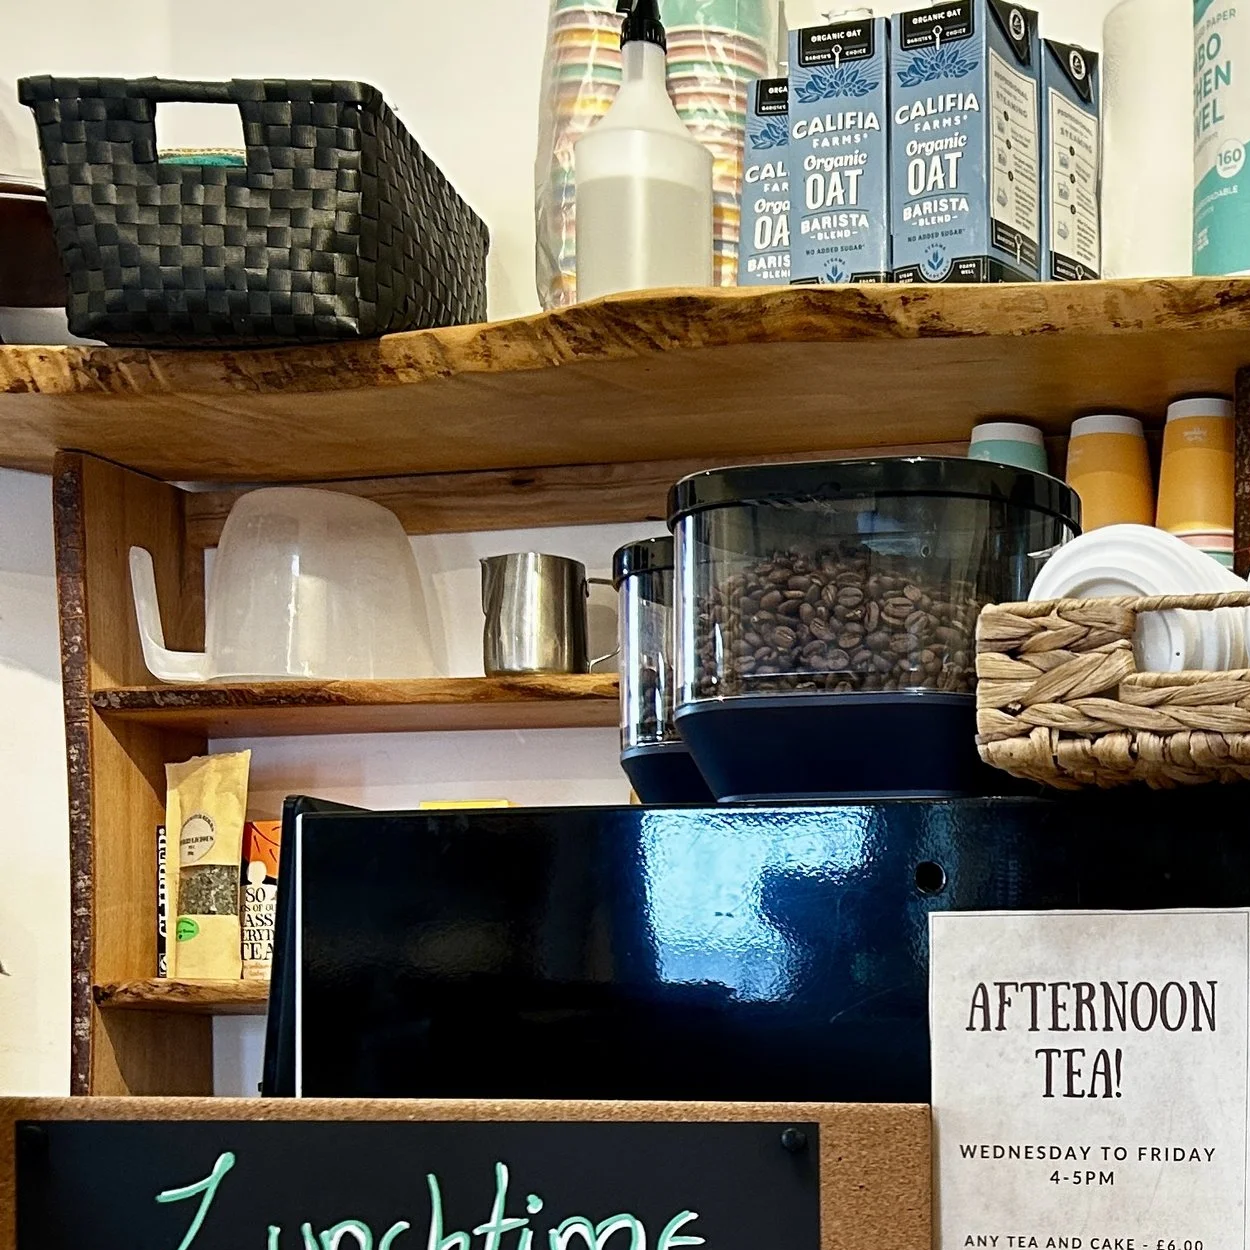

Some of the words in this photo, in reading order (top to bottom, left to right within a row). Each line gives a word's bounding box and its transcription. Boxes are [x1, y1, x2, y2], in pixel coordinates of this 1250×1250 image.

[1206, 8, 1236, 29] PAPER
[894, 92, 980, 125] CALIFIA
[792, 111, 880, 139] CALIFIA
[906, 132, 968, 157] Organic
[804, 149, 868, 171] Organic
[1217, 148, 1242, 166] 160
[908, 151, 963, 196] OAT
[805, 169, 863, 210] OAT
[903, 198, 969, 221] BARISTA
[801, 214, 869, 234] BARISTA
[965, 981, 1218, 1032] AFTERNOON
[1035, 1048, 1124, 1099] TEA!
[959, 1144, 1092, 1161] WEDNESDAY
[1101, 1146, 1128, 1161] TO
[1138, 1147, 1216, 1162] FRIDAY
[1049, 1170, 1115, 1186] 4-5PM
[964, 1234, 999, 1248] ANY
[1007, 1236, 1038, 1249] TEA
[1045, 1237, 1082, 1250] AND
[1090, 1237, 1135, 1250] CAKE
